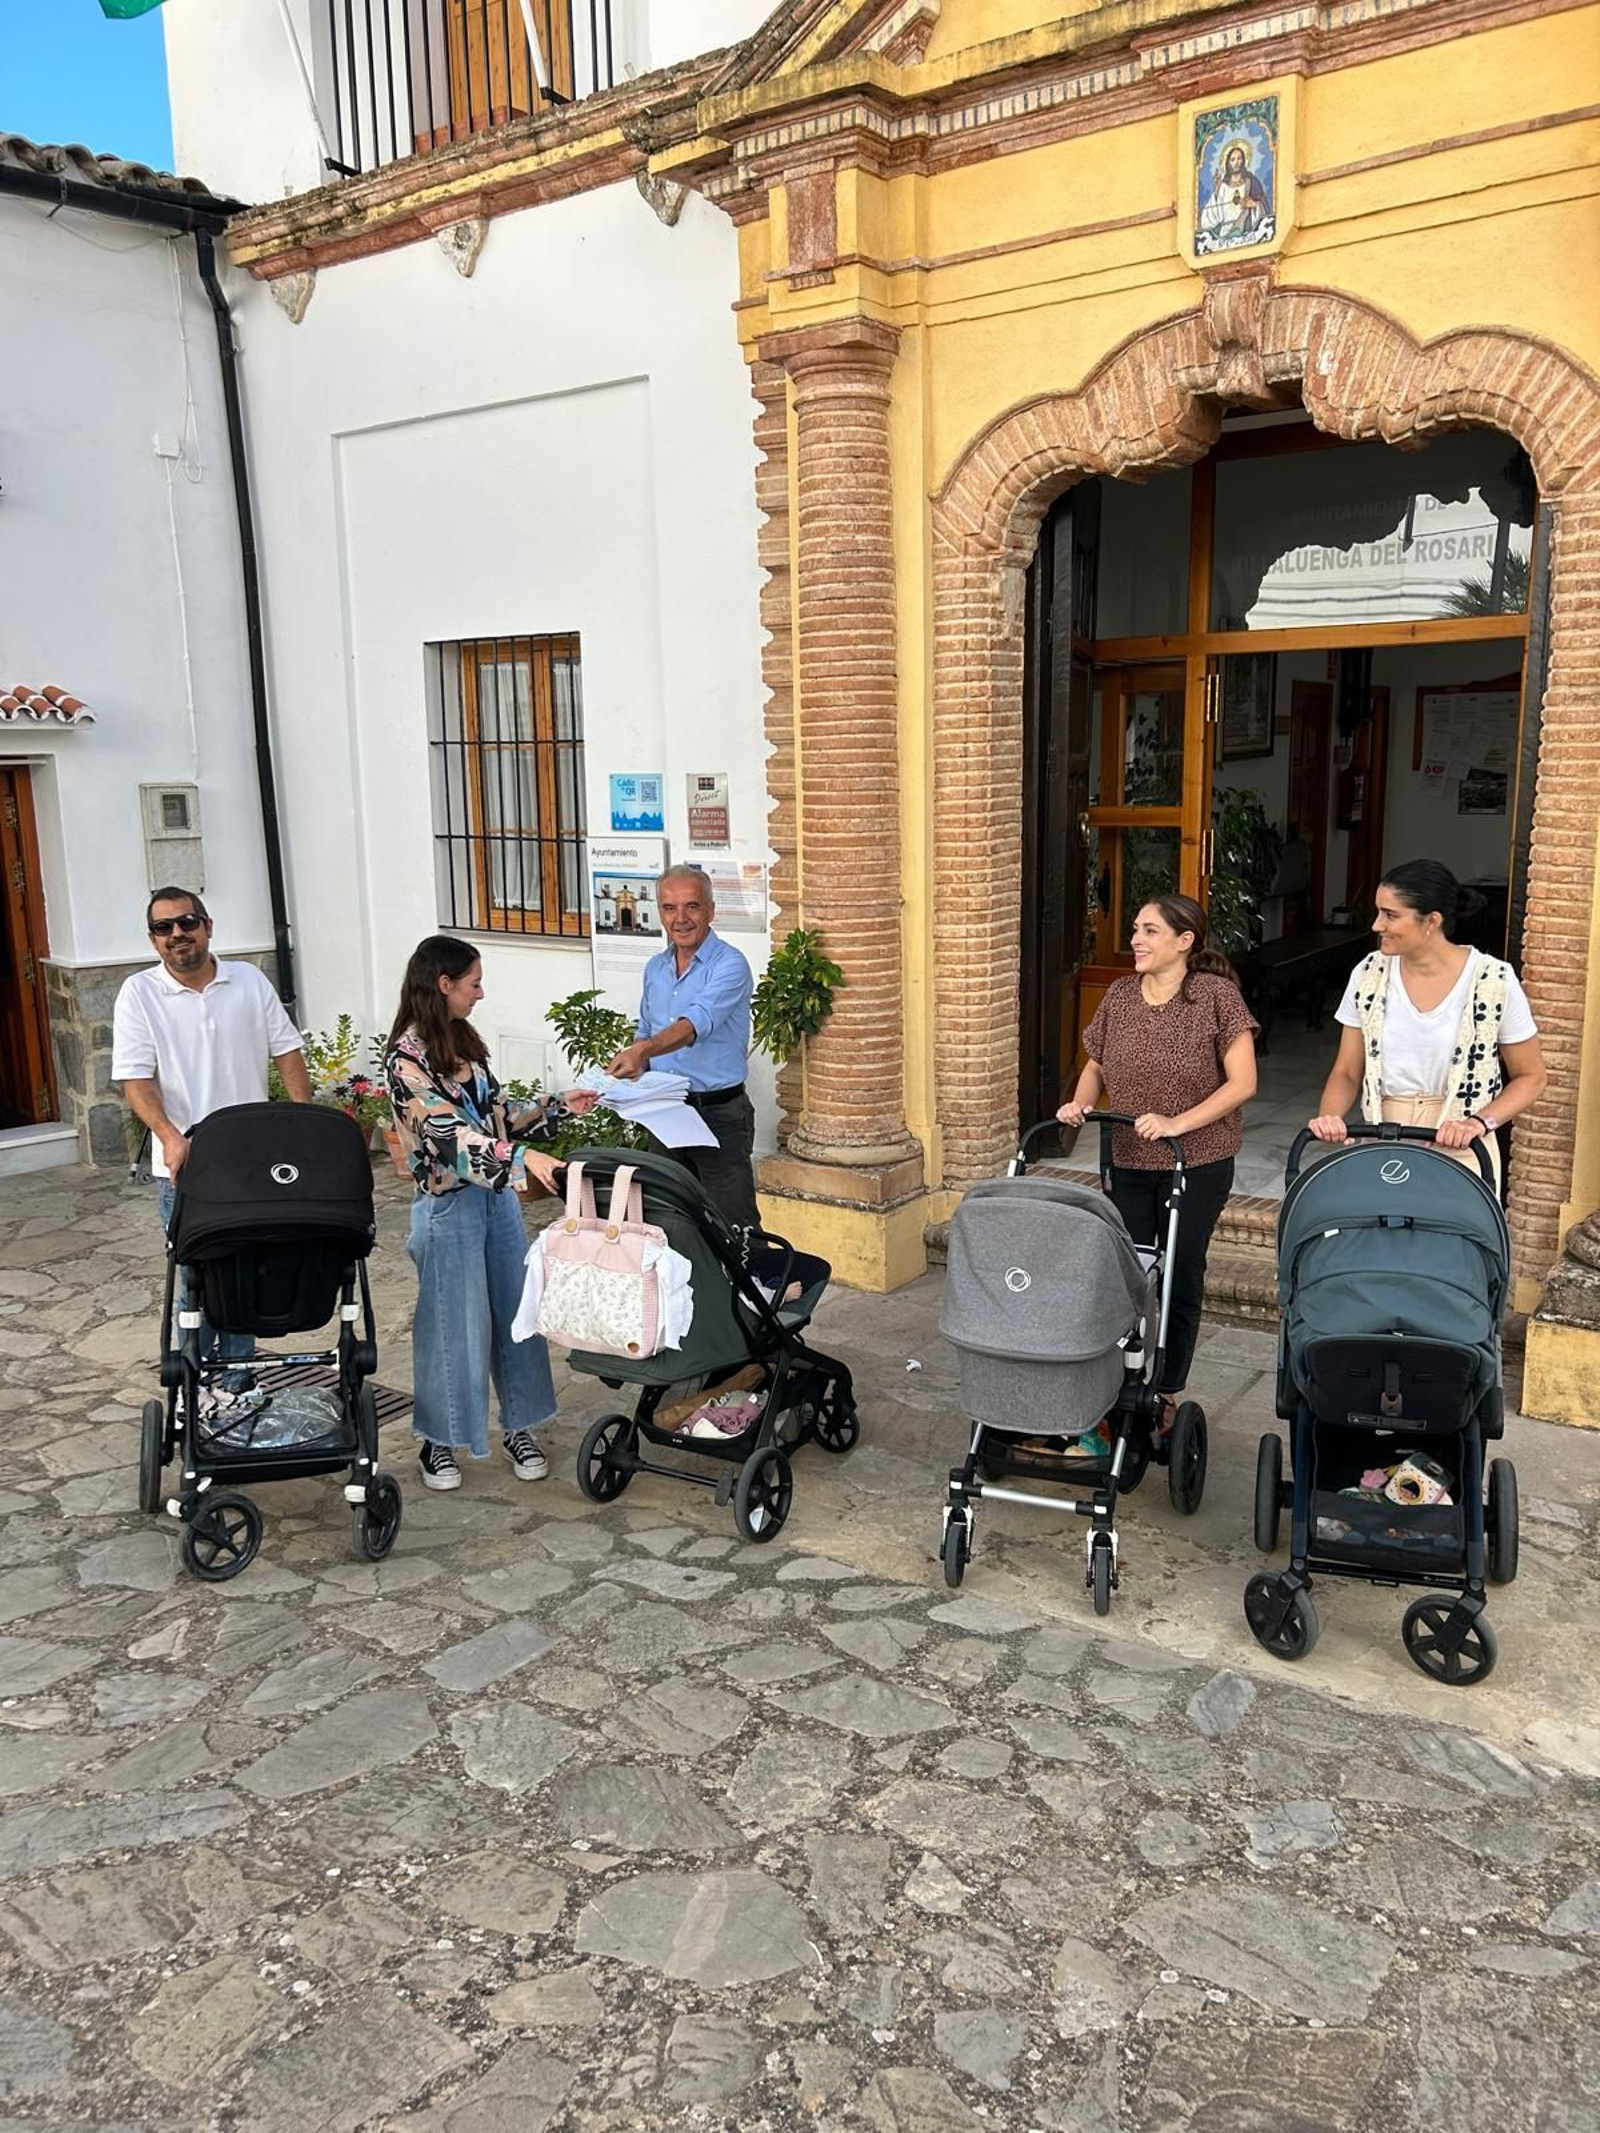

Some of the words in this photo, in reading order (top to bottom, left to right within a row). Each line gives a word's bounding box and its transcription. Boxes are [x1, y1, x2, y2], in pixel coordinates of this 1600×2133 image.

[1369, 542, 1408, 567] DEL
[1415, 534, 1494, 564] ROSARI
[691, 808, 726, 818] Alarma
[591, 847, 638, 859] Ayuntamiento
